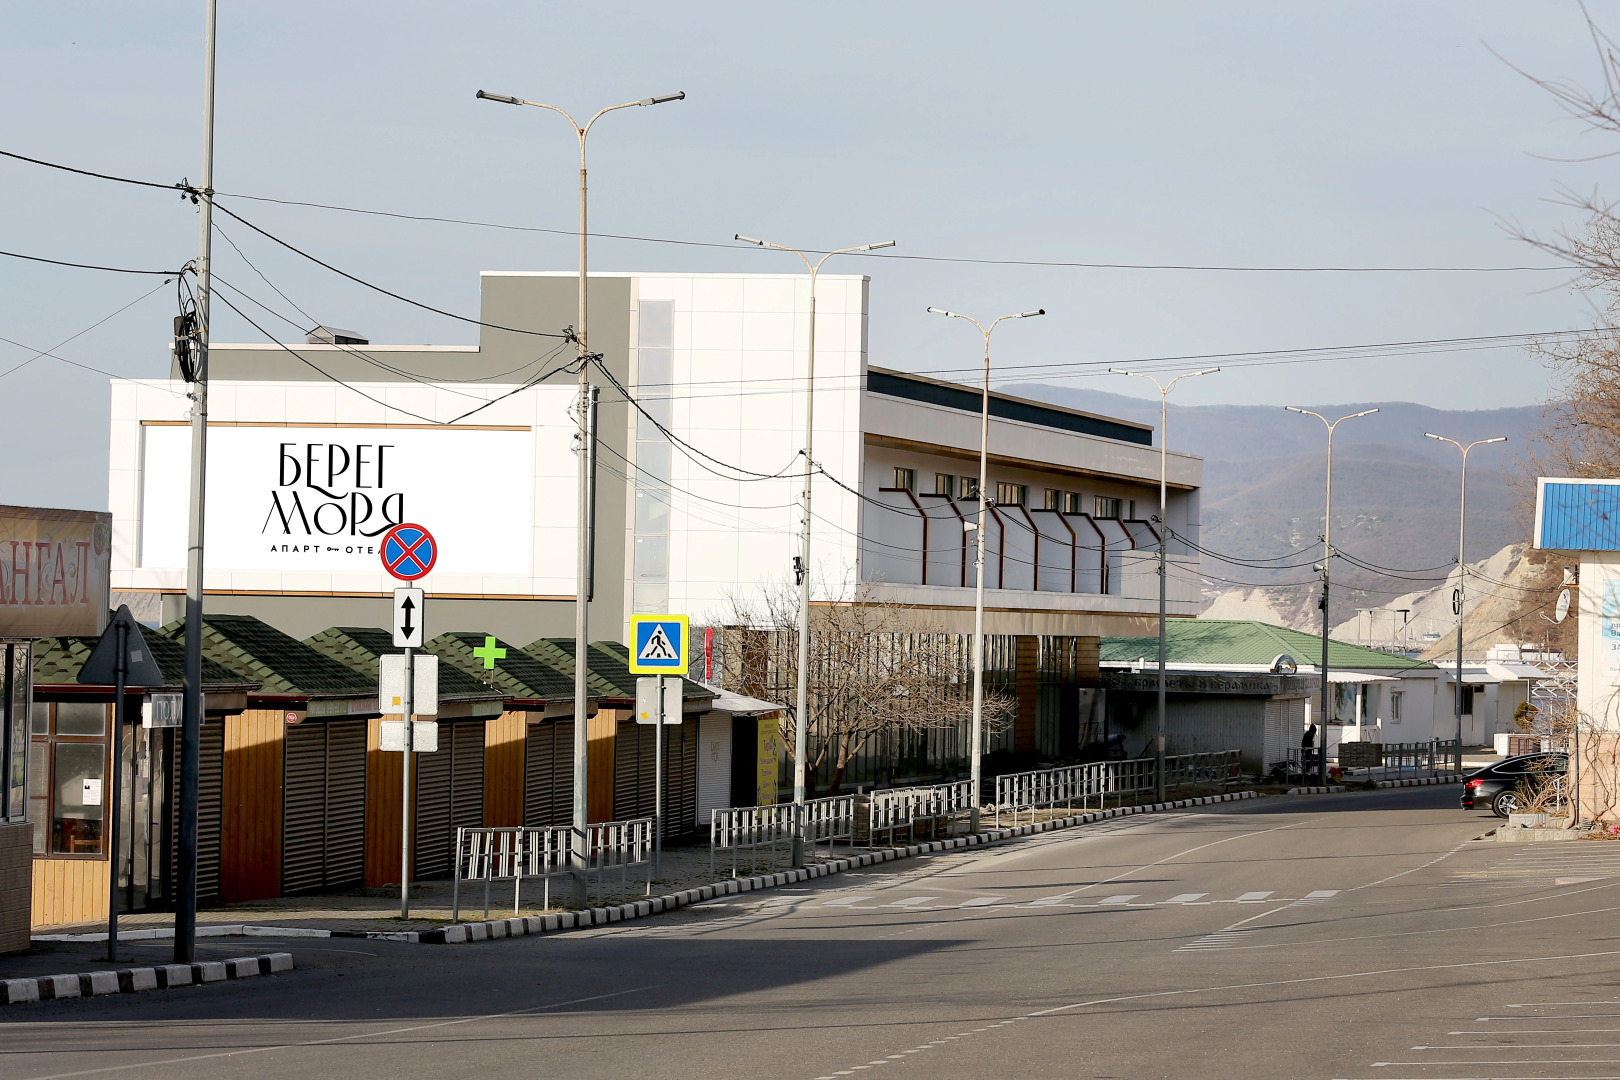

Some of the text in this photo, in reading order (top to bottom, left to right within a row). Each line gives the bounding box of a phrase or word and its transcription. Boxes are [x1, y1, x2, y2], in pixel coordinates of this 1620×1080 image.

[279, 442, 395, 500] БЕРЕГ
[270, 544, 381, 555] АПАРТ ОТЕ
